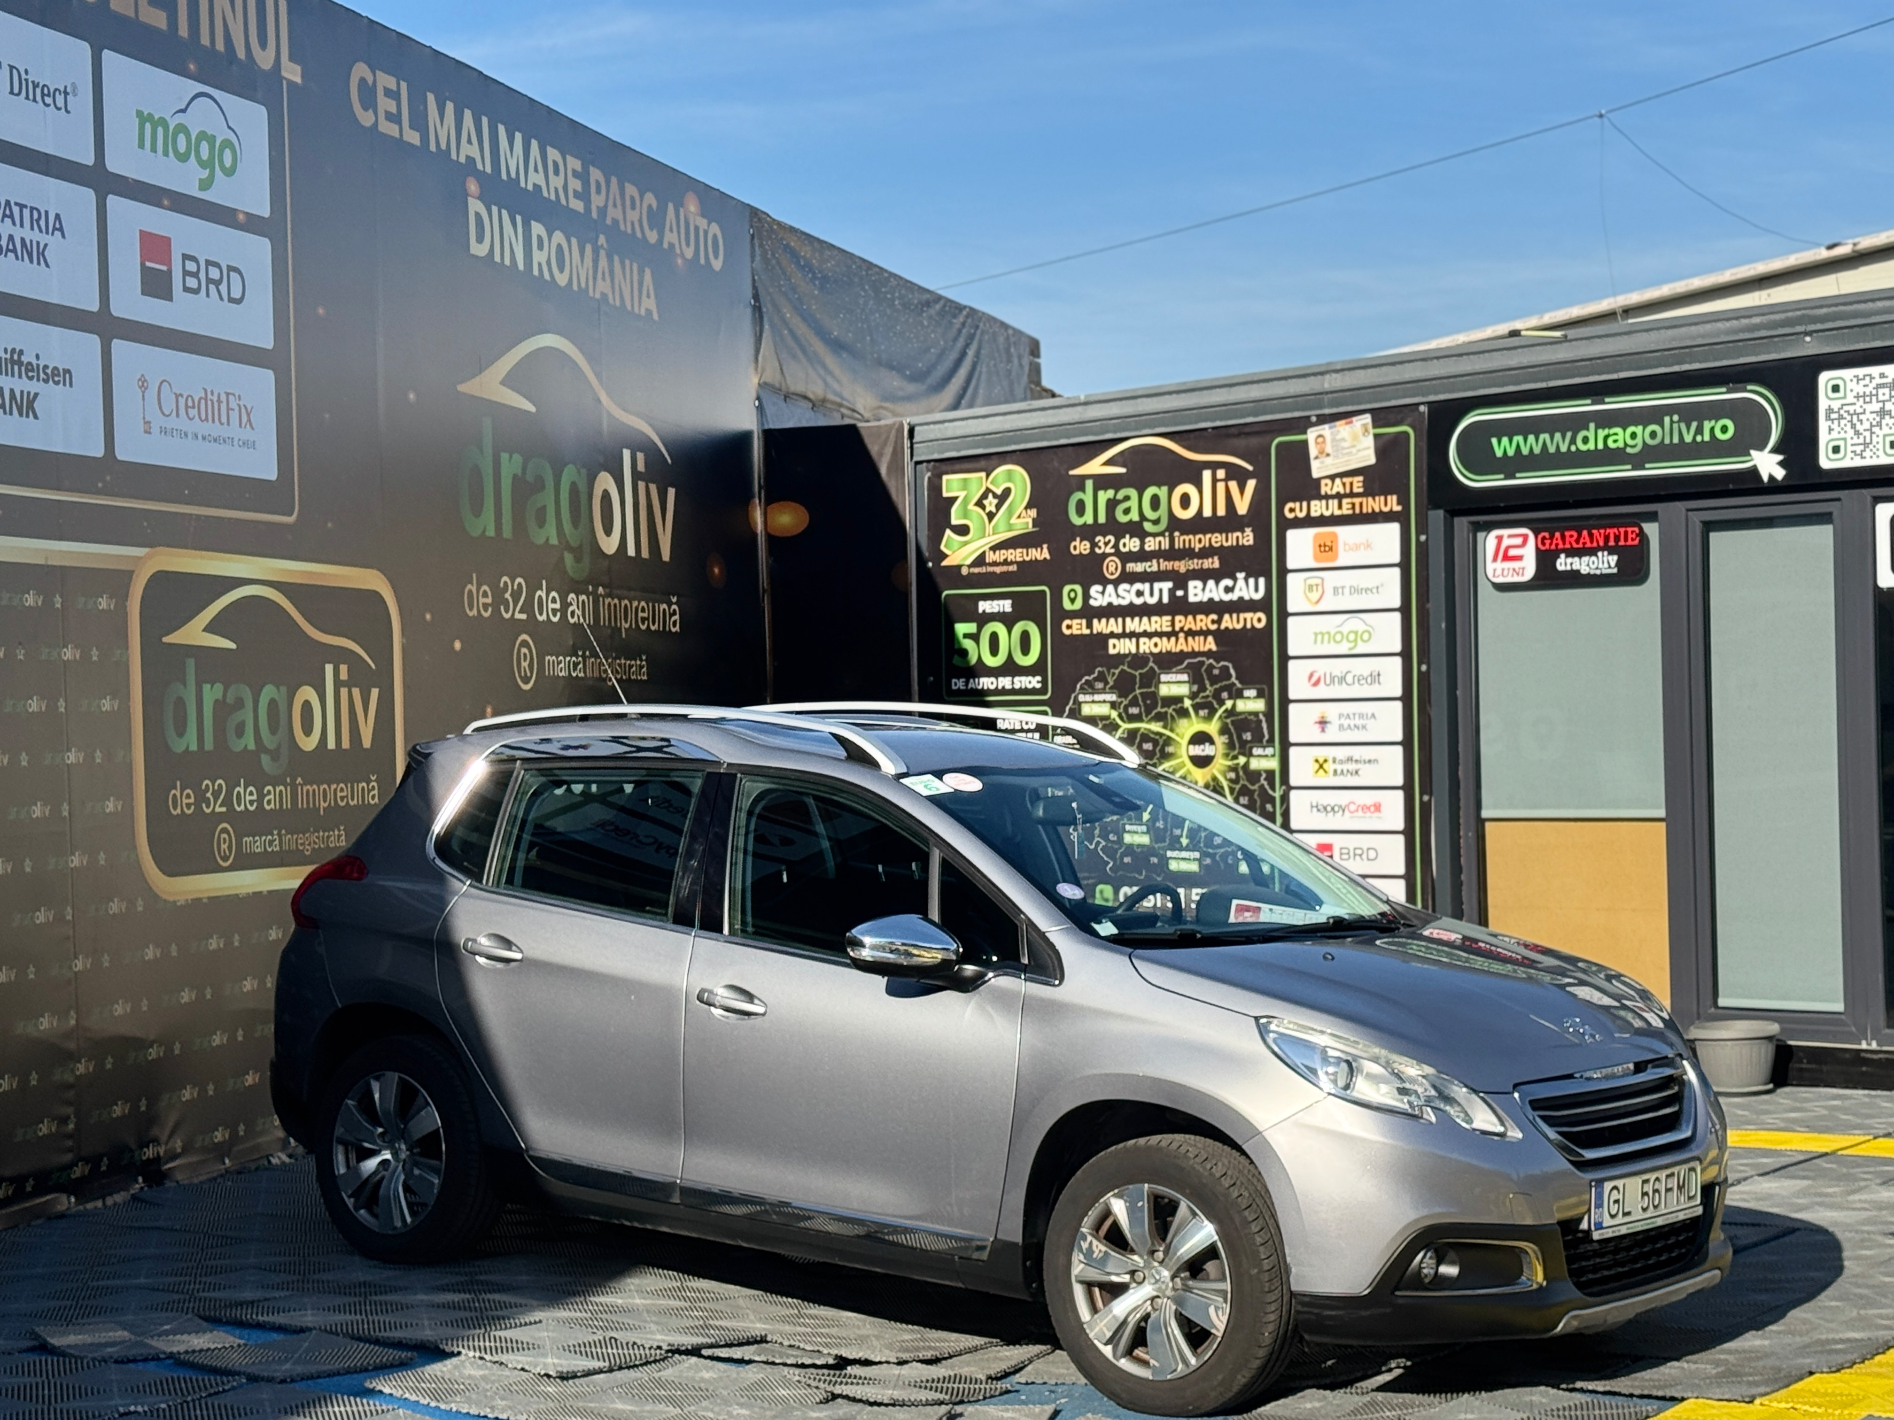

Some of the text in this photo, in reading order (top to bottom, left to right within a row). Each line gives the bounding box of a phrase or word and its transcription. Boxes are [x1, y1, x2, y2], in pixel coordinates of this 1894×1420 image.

[136, 108, 238, 191] mogo
[349, 61, 724, 272] CEL MAI MARE PARC AUTO
[0, 199, 66, 240] ATRIA
[467, 196, 659, 321] DIN ROMÂNIA
[181, 253, 246, 305] BRD
[157, 378, 255, 431] CreditFix
[159, 426, 189, 440] PRIETEN
[190, 430, 199, 442] IN
[201, 433, 235, 448] MOMENTE
[1490, 414, 1735, 458] www.dragoliv.ro
[1320, 476, 1364, 495] RATE
[457, 416, 676, 581] dragoliv
[940, 463, 1037, 555] 32 ANI
[1068, 469, 1257, 533] dragoliv
[1284, 495, 1402, 519] CU BULETINUL
[1070, 528, 1255, 555] de 32 de ani împreună
[1318, 541, 1373, 554] tbi bank
[1491, 533, 1529, 563] 12
[1537, 526, 1640, 550] GARANTIE
[985, 543, 1050, 564] ÎMPREUNĂ
[1126, 559, 1158, 573] marcă
[1159, 556, 1220, 574] înregistrată
[1556, 551, 1618, 574] dragoliv
[1492, 566, 1526, 578] LUNI
[1089, 581, 1173, 608] SASCUT
[1187, 573, 1266, 603] BACĂU
[1308, 583, 1320, 594] BT
[1333, 585, 1346, 597] BT
[464, 573, 681, 638] de 32 de ani împreună
[978, 599, 1012, 614] PESTE
[1061, 611, 1267, 635] CEL MAI MARE PARC AUTO
[952, 620, 1042, 668] 500
[1108, 633, 1217, 655] DIN ROMÂNIA
[1313, 629, 1372, 651] mogo
[545, 650, 584, 678] marcă
[585, 652, 648, 686] înregistrată
[1323, 670, 1382, 687] UniCredit
[951, 676, 1042, 690] DE AUTO PE STOC
[163, 658, 380, 776] dragoliv
[997, 718, 1021, 730] RATE
[1338, 712, 1377, 721] PATRIA
[1338, 723, 1368, 732] BANK
[1188, 742, 1216, 757] BACĂU
[1332, 755, 1379, 766] Raiffeisen
[1332, 768, 1361, 777] BANK
[168, 774, 380, 816] de 32 de ani împreună
[1310, 801, 1383, 817] HappyCredit
[242, 828, 280, 854] marcă
[281, 826, 347, 856] înregistrată
[1339, 847, 1378, 861] BRD
[1606, 1184, 1632, 1220] GL
